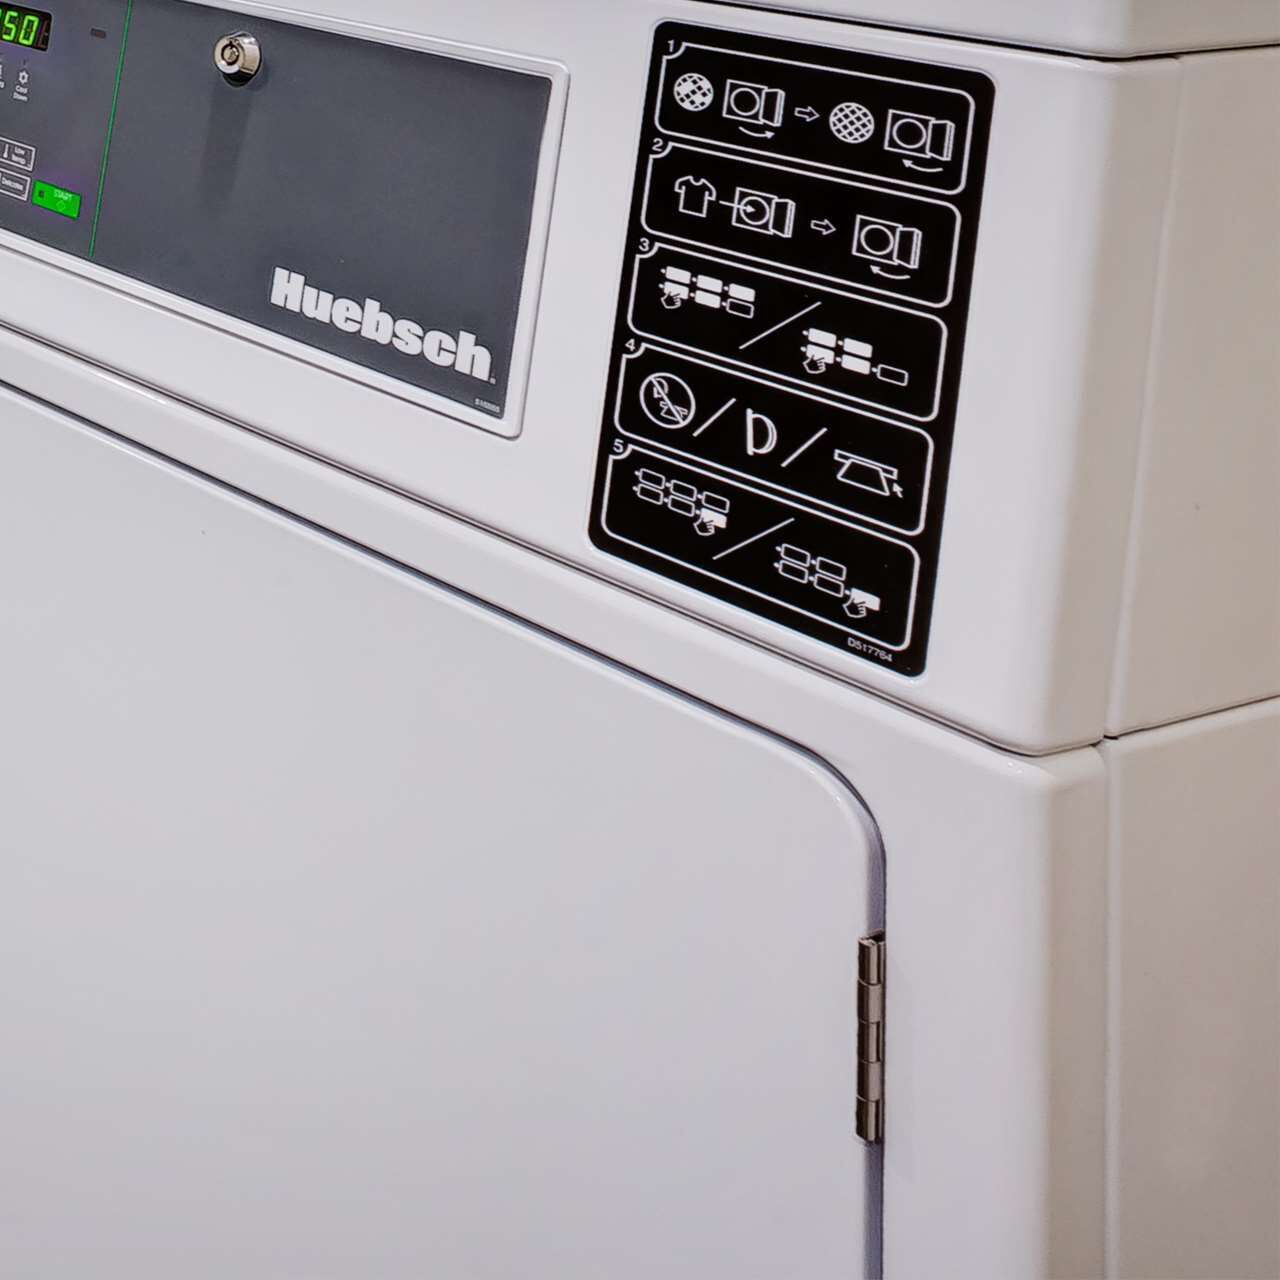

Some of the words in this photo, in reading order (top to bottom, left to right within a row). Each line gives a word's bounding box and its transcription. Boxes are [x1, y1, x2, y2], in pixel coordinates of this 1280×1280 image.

[667, 39, 675, 52] 1
[652, 138, 664, 152] 2
[638, 237, 650, 252] 3
[270, 266, 492, 383] Huebsch
[624, 338, 636, 352] 4
[613, 439, 625, 453] 5
